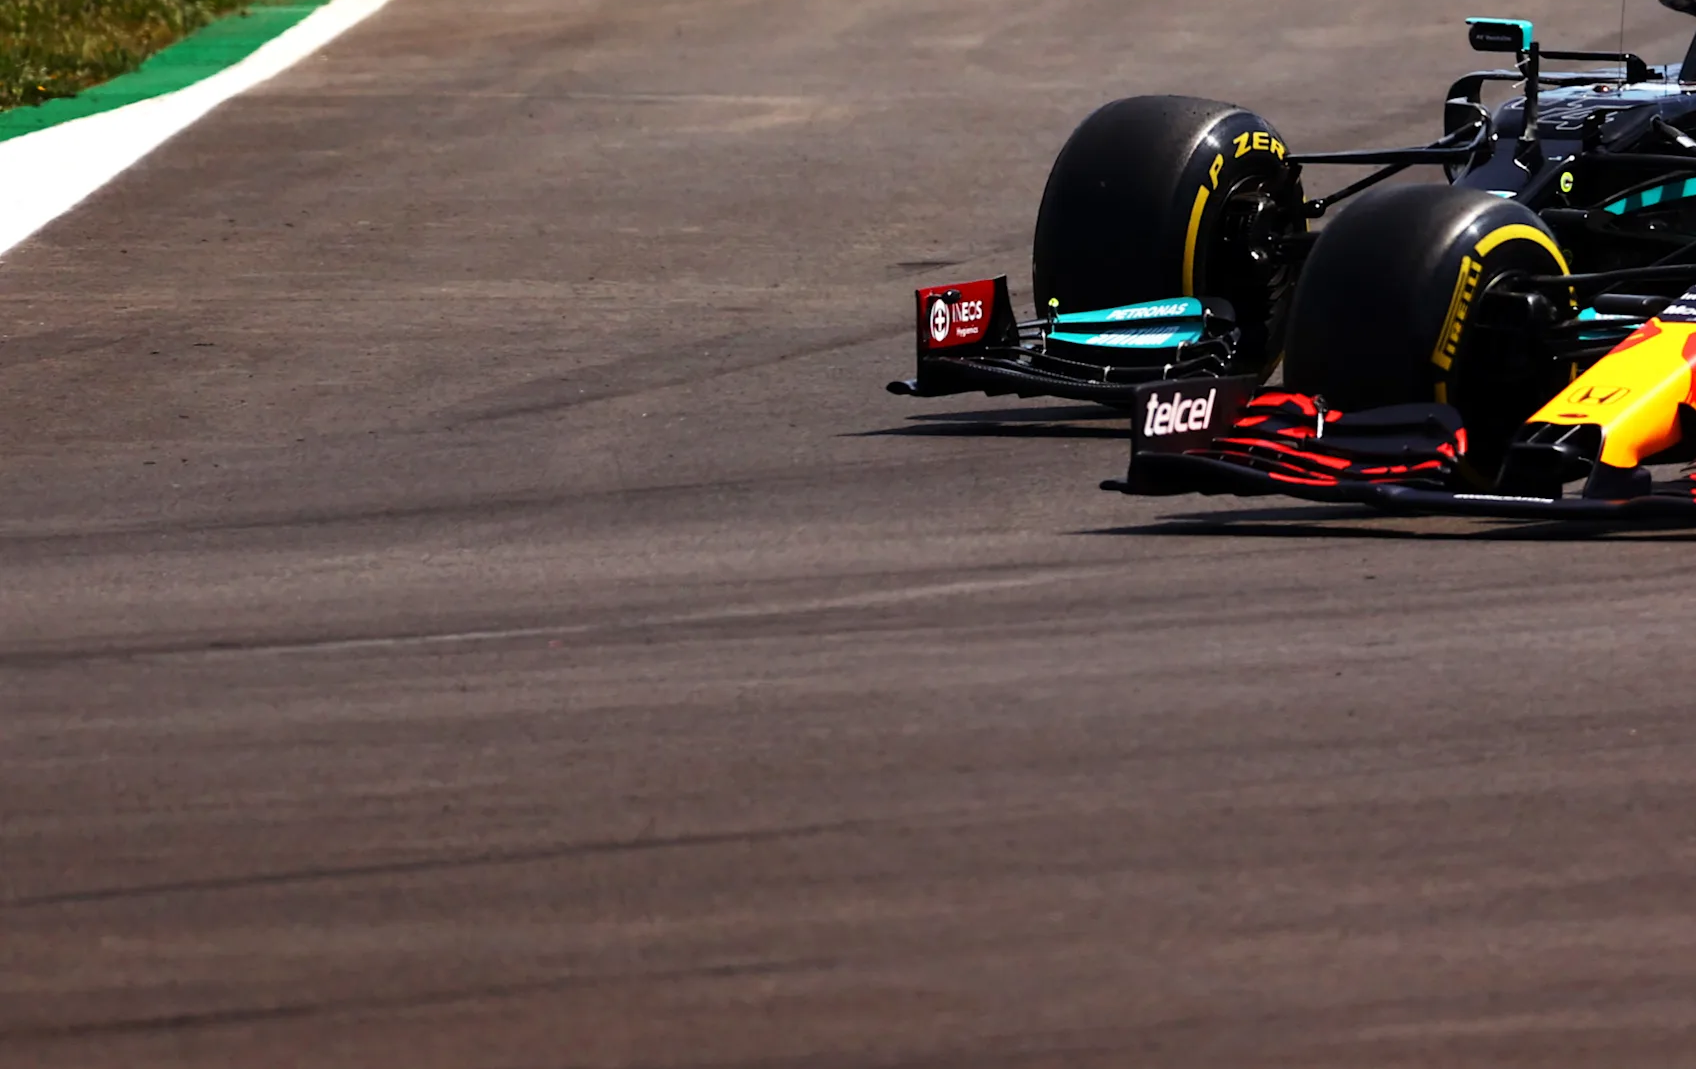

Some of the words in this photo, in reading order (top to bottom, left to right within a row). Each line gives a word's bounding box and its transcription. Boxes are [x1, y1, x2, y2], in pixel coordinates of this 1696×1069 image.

[1209, 153, 1224, 190] P
[1233, 131, 1289, 167] ZER
[952, 300, 983, 323] INEOS
[1106, 303, 1188, 321] PETRONAS
[1144, 388, 1217, 437] telcel
